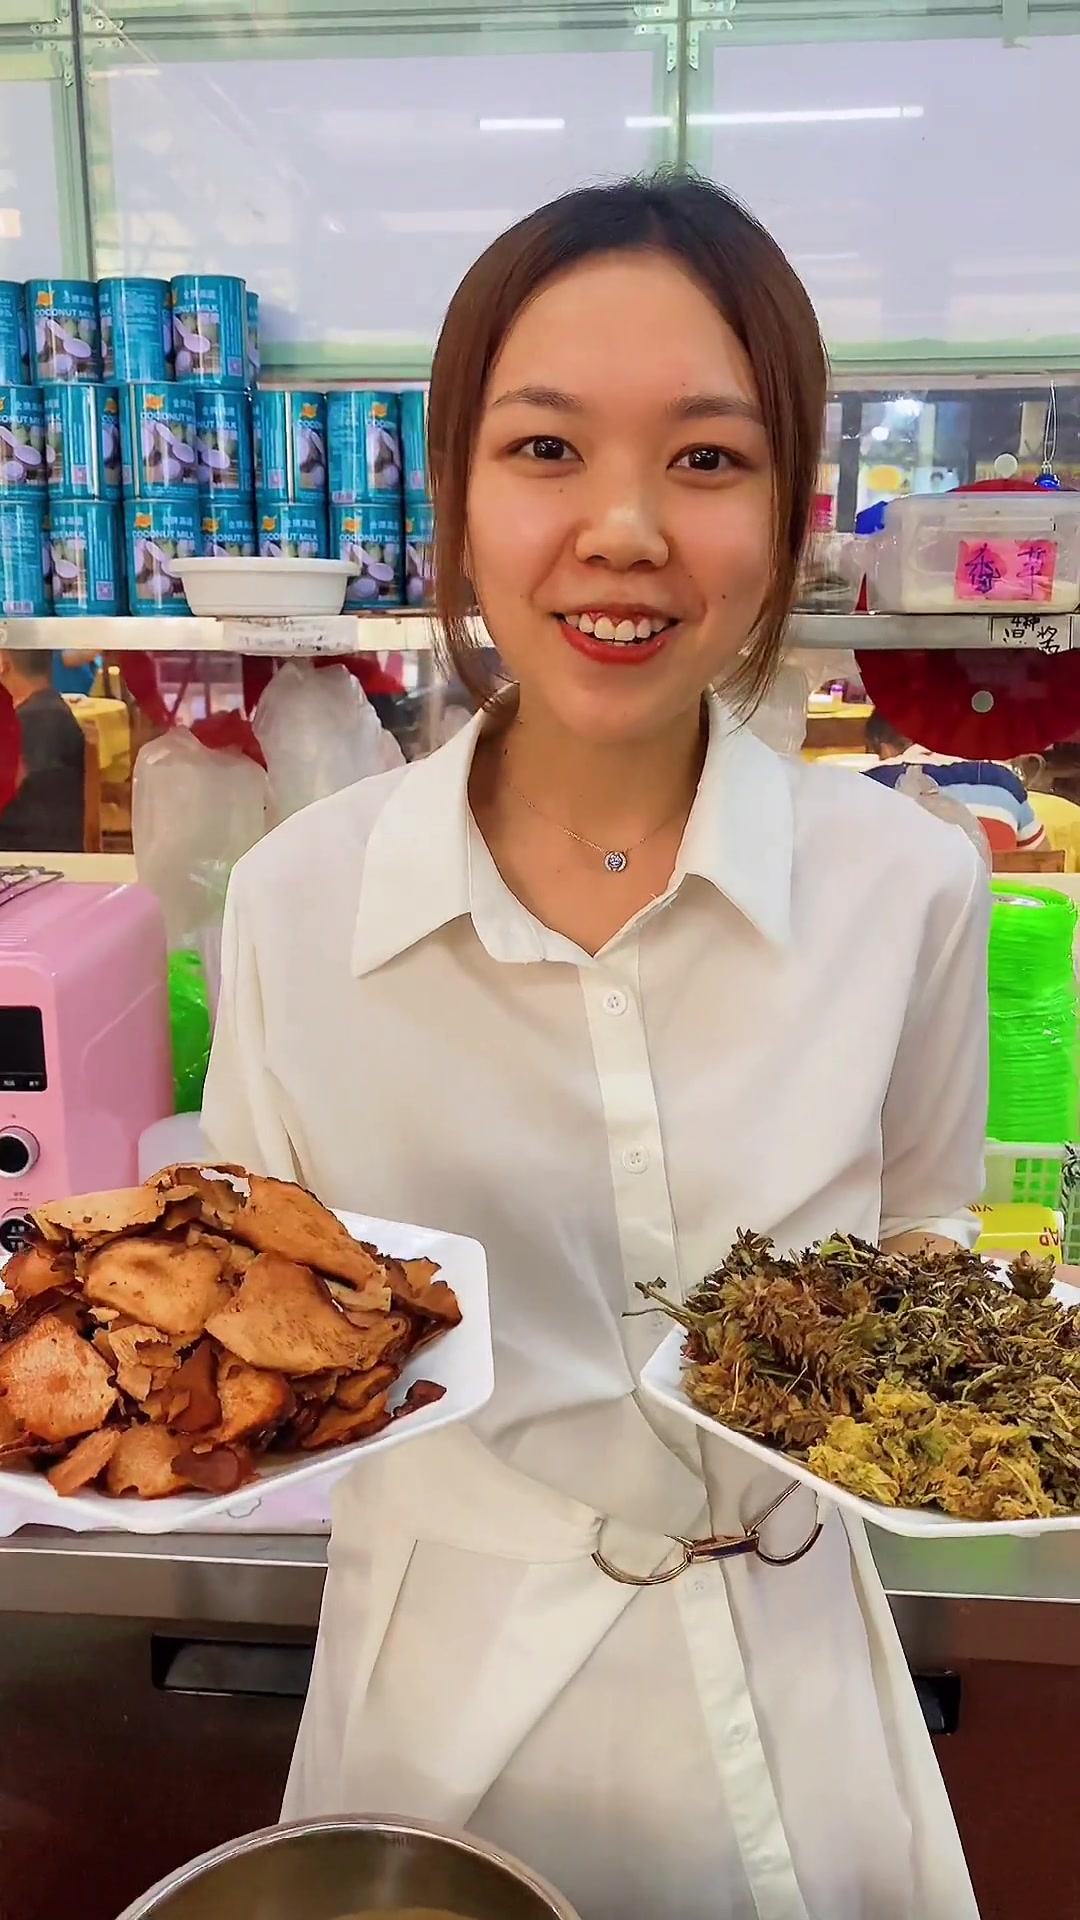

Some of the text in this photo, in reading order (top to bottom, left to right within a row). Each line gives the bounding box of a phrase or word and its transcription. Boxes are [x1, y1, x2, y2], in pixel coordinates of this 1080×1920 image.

[34, 308, 77, 318] COCONUT
[140, 412, 184, 422] COCONUT
[131, 530, 175, 540] COCONUT
[339, 534, 382, 542] COCONUT
